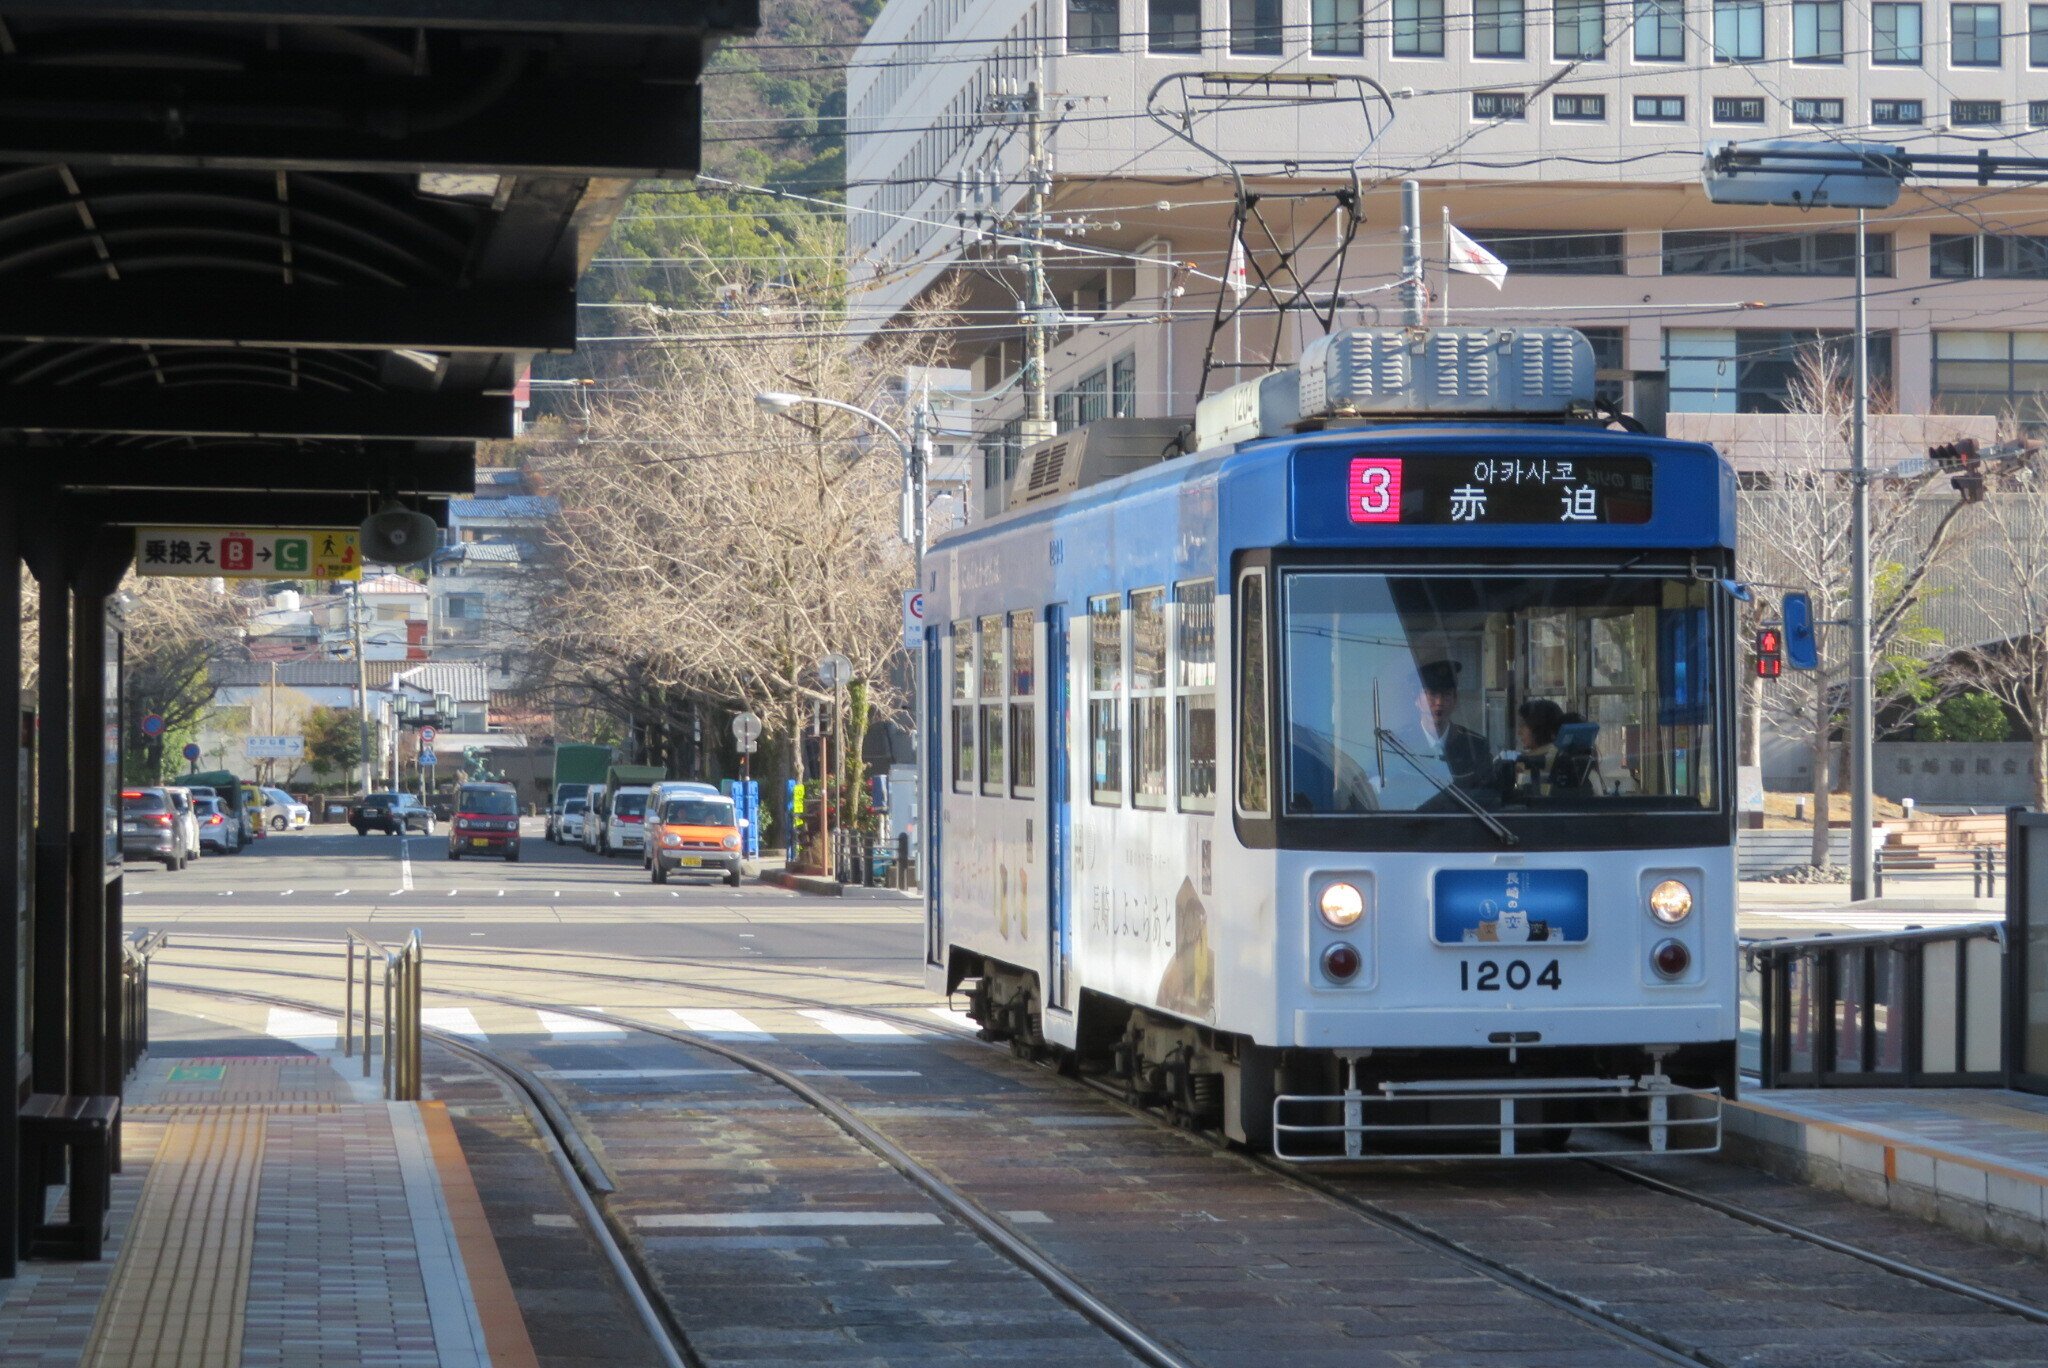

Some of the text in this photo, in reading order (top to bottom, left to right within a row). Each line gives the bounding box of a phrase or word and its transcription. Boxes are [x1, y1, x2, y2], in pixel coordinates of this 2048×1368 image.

[1474, 459, 1576, 485] 아카사코
[1360, 466, 1392, 514] 3
[145, 540, 299, 565] 乗換え B C
[1460, 959, 1562, 991] 1204
